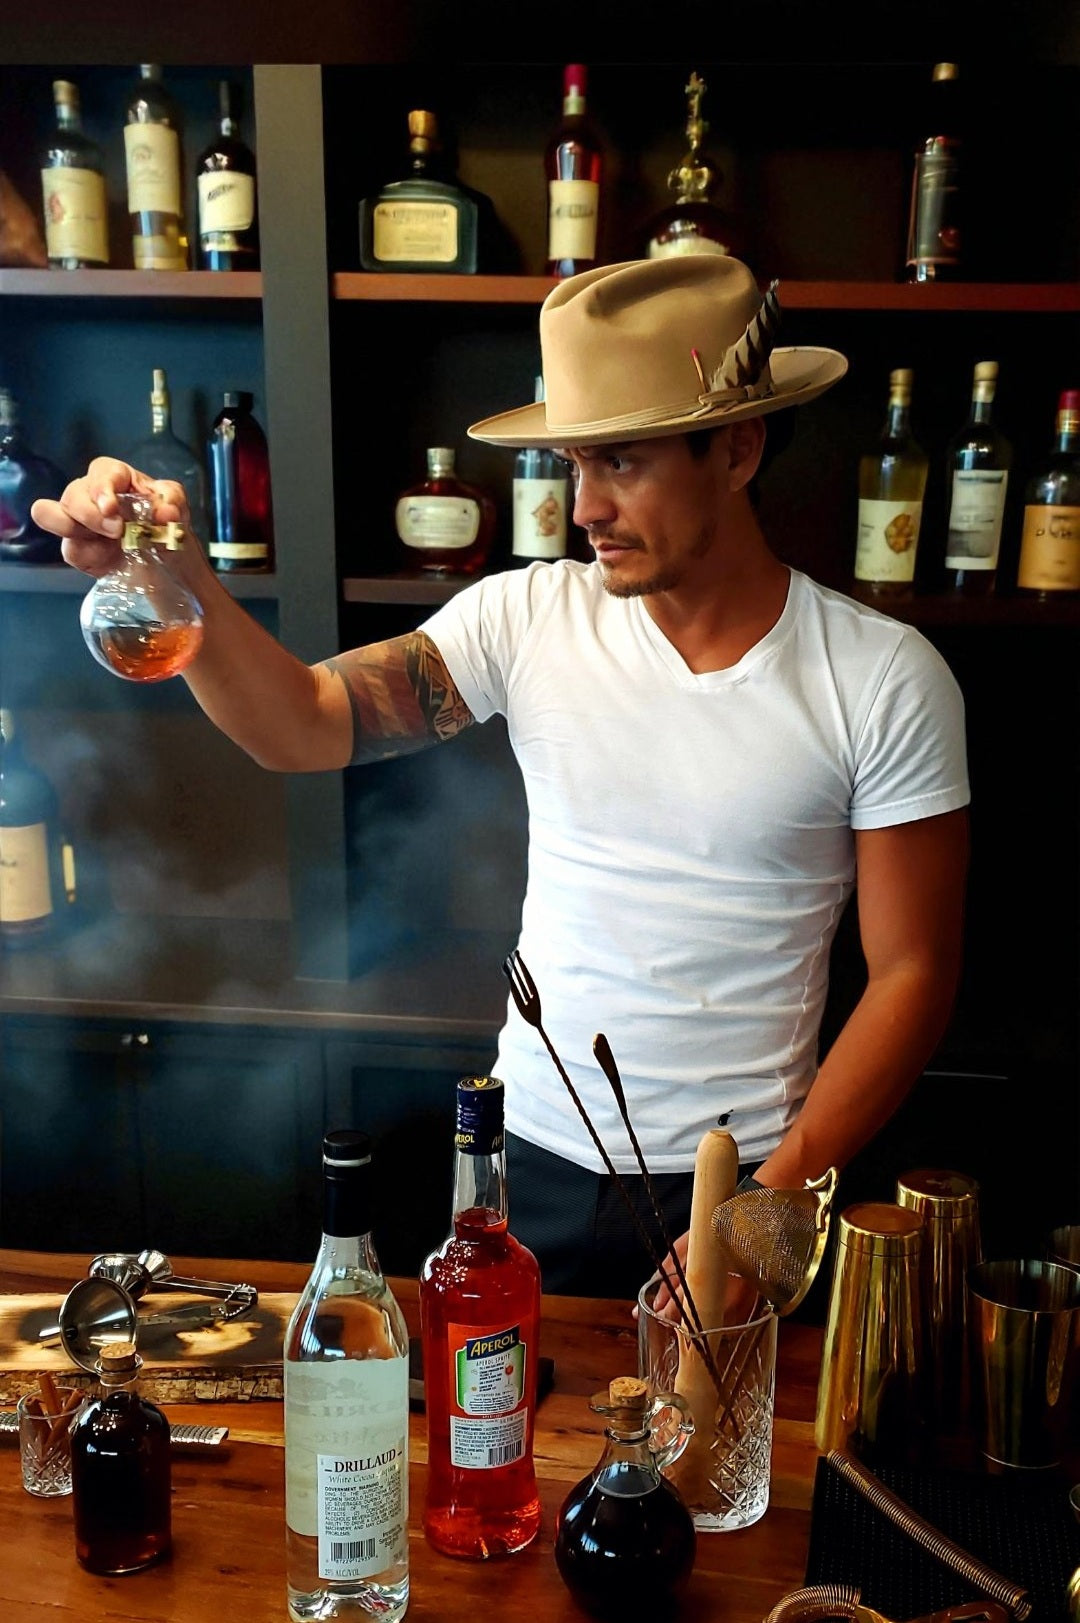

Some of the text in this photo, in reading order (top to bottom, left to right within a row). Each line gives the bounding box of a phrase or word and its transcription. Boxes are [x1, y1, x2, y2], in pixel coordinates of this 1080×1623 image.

[470, 1333, 516, 1357] APEROL
[334, 1448, 396, 1473] DRILLAUD
[329, 1474, 351, 1484] White
